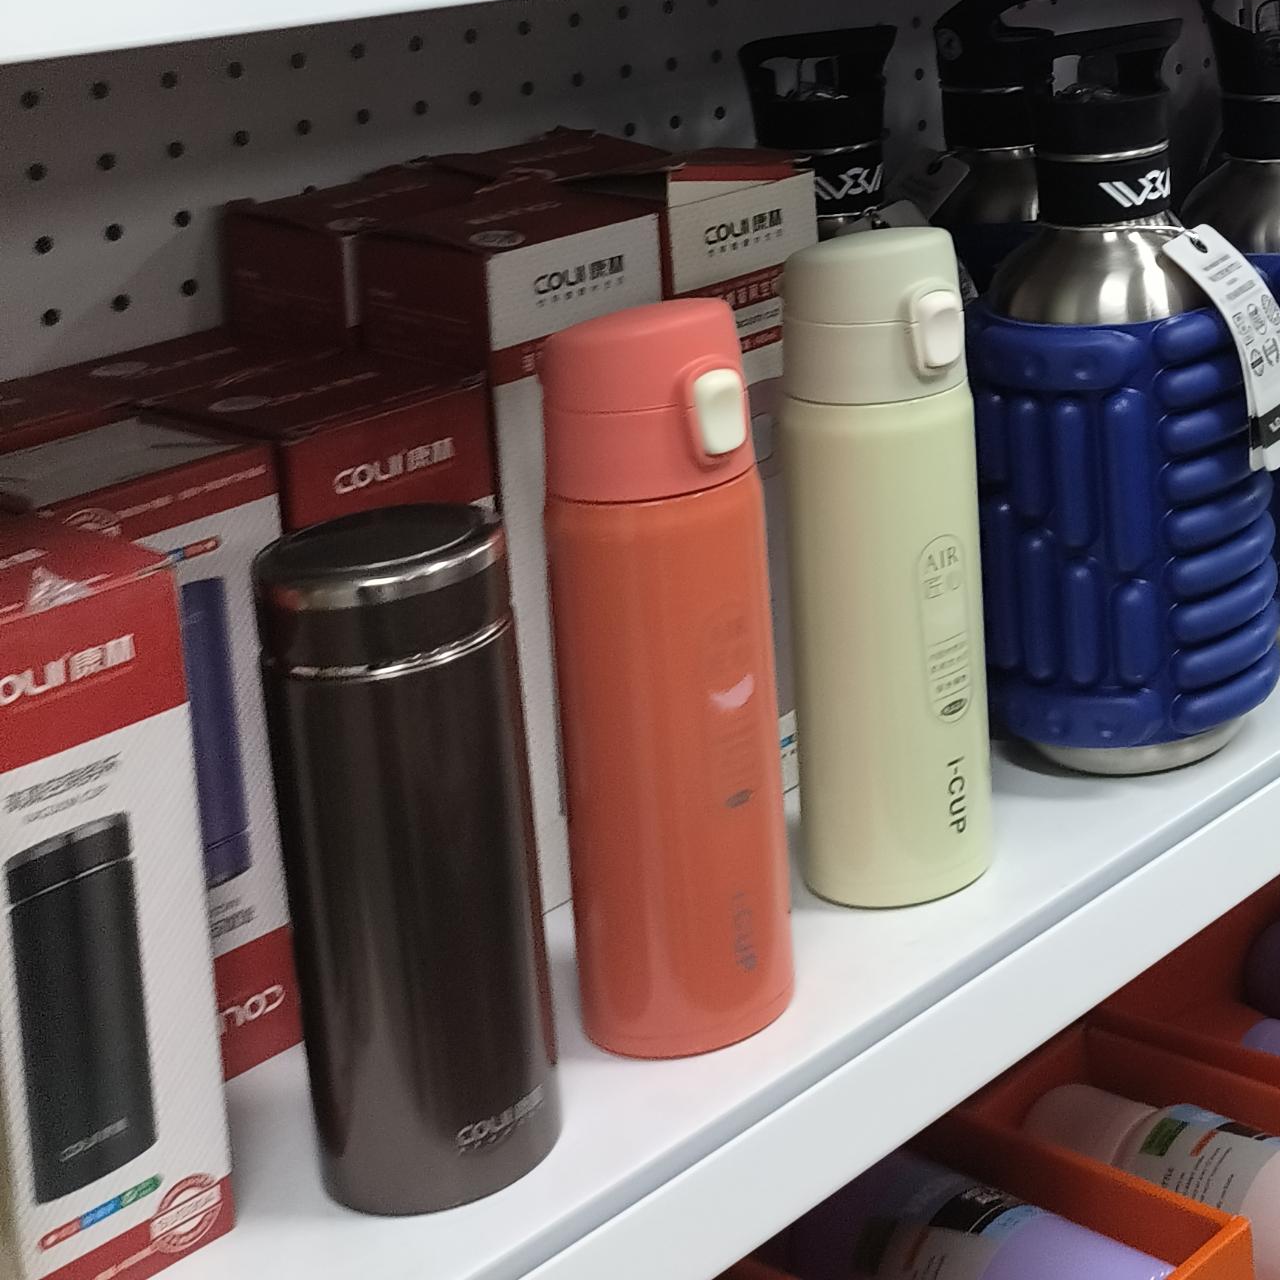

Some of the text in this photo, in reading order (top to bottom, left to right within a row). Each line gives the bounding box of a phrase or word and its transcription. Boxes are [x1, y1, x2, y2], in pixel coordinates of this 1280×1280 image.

[926, 545, 960, 572] AIR
[0, 651, 69, 706] OLI
[947, 755, 967, 834] I-CUP
